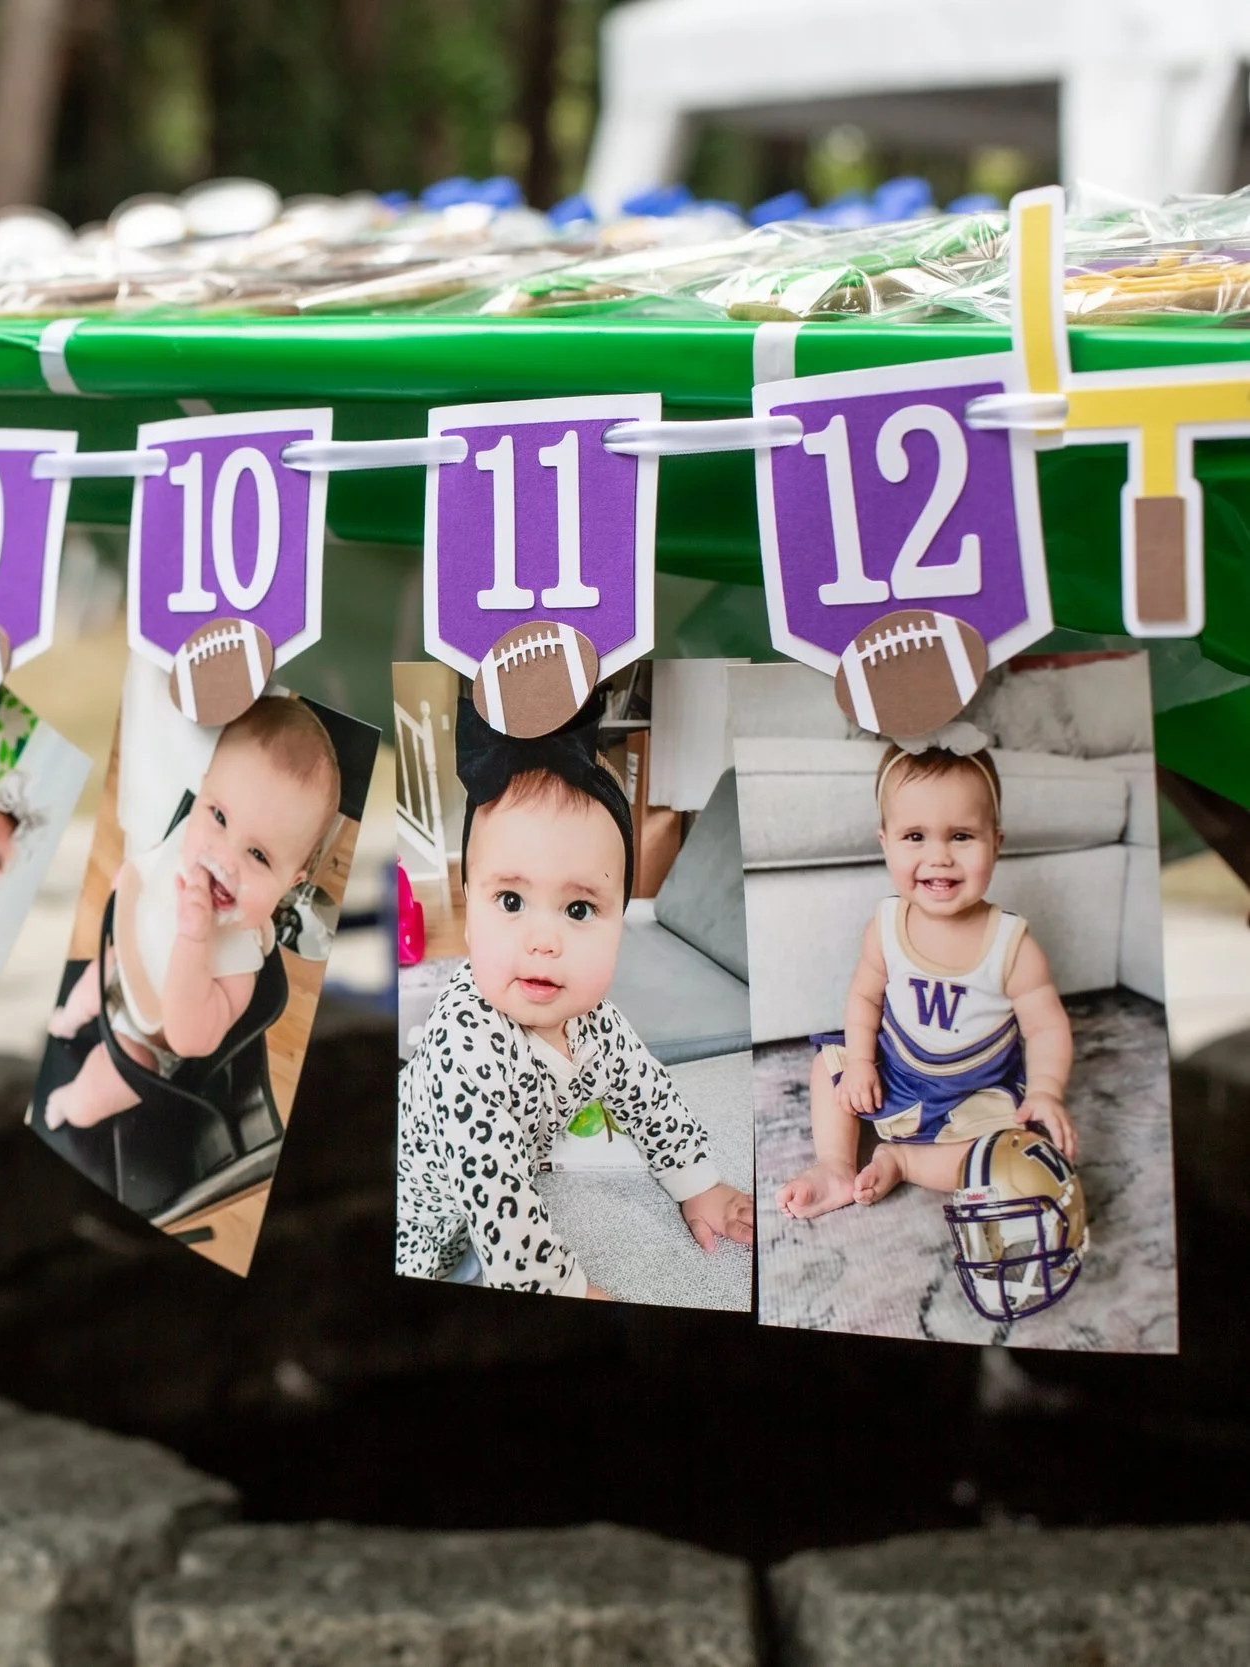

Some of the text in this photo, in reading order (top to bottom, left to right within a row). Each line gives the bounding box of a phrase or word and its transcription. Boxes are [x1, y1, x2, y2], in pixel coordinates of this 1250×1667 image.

[167, 447, 280, 613] 10
[475, 430, 600, 610] 11
[803, 404, 982, 606] 12
[908, 977, 966, 1031] W
